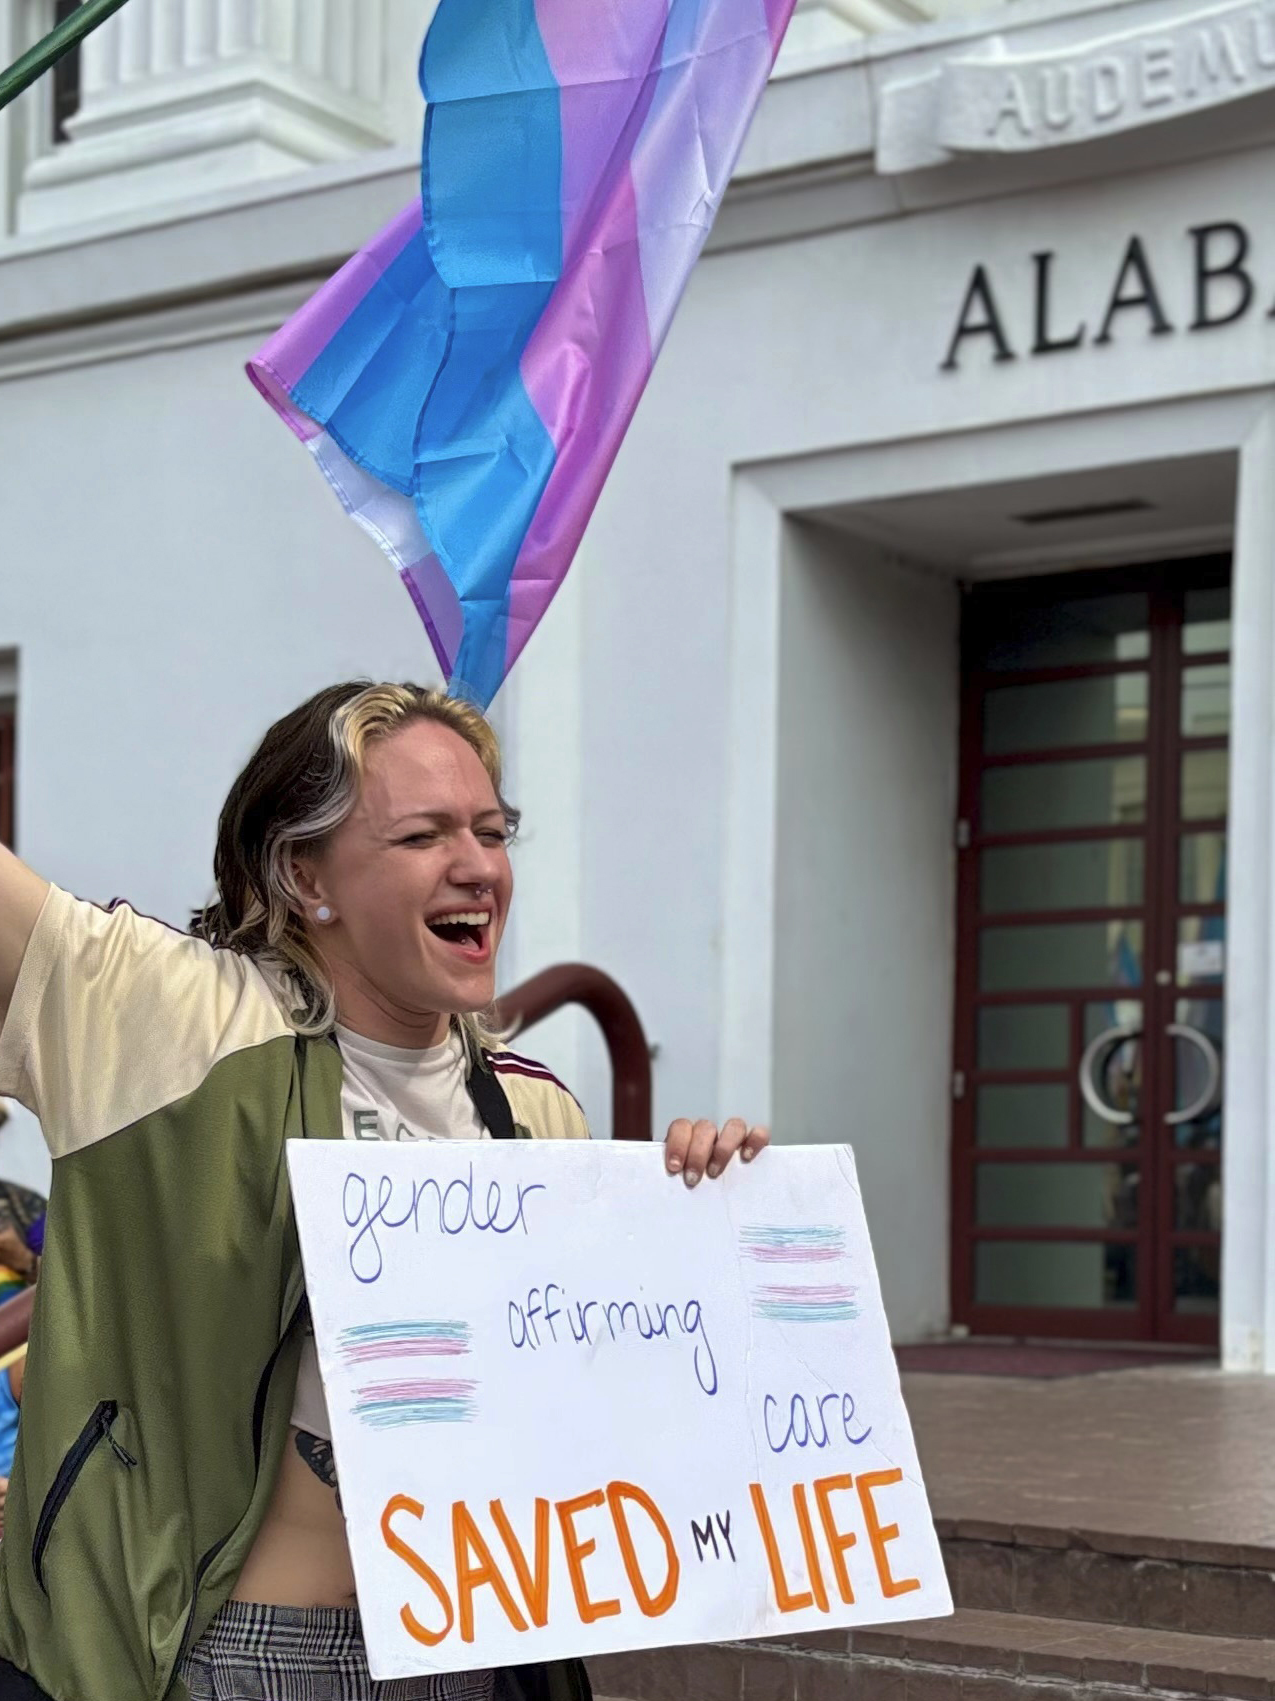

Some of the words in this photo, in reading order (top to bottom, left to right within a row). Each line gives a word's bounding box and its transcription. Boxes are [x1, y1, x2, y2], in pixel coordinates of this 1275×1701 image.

[940, 219, 1275, 372] ALAB
[341, 1161, 547, 1284] gender
[507, 1284, 719, 1397] affirming
[762, 1390, 873, 1454] care
[379, 1480, 681, 1647] SAVED
[690, 1509, 738, 1563] MY
[748, 1467, 922, 1614] LIFE
